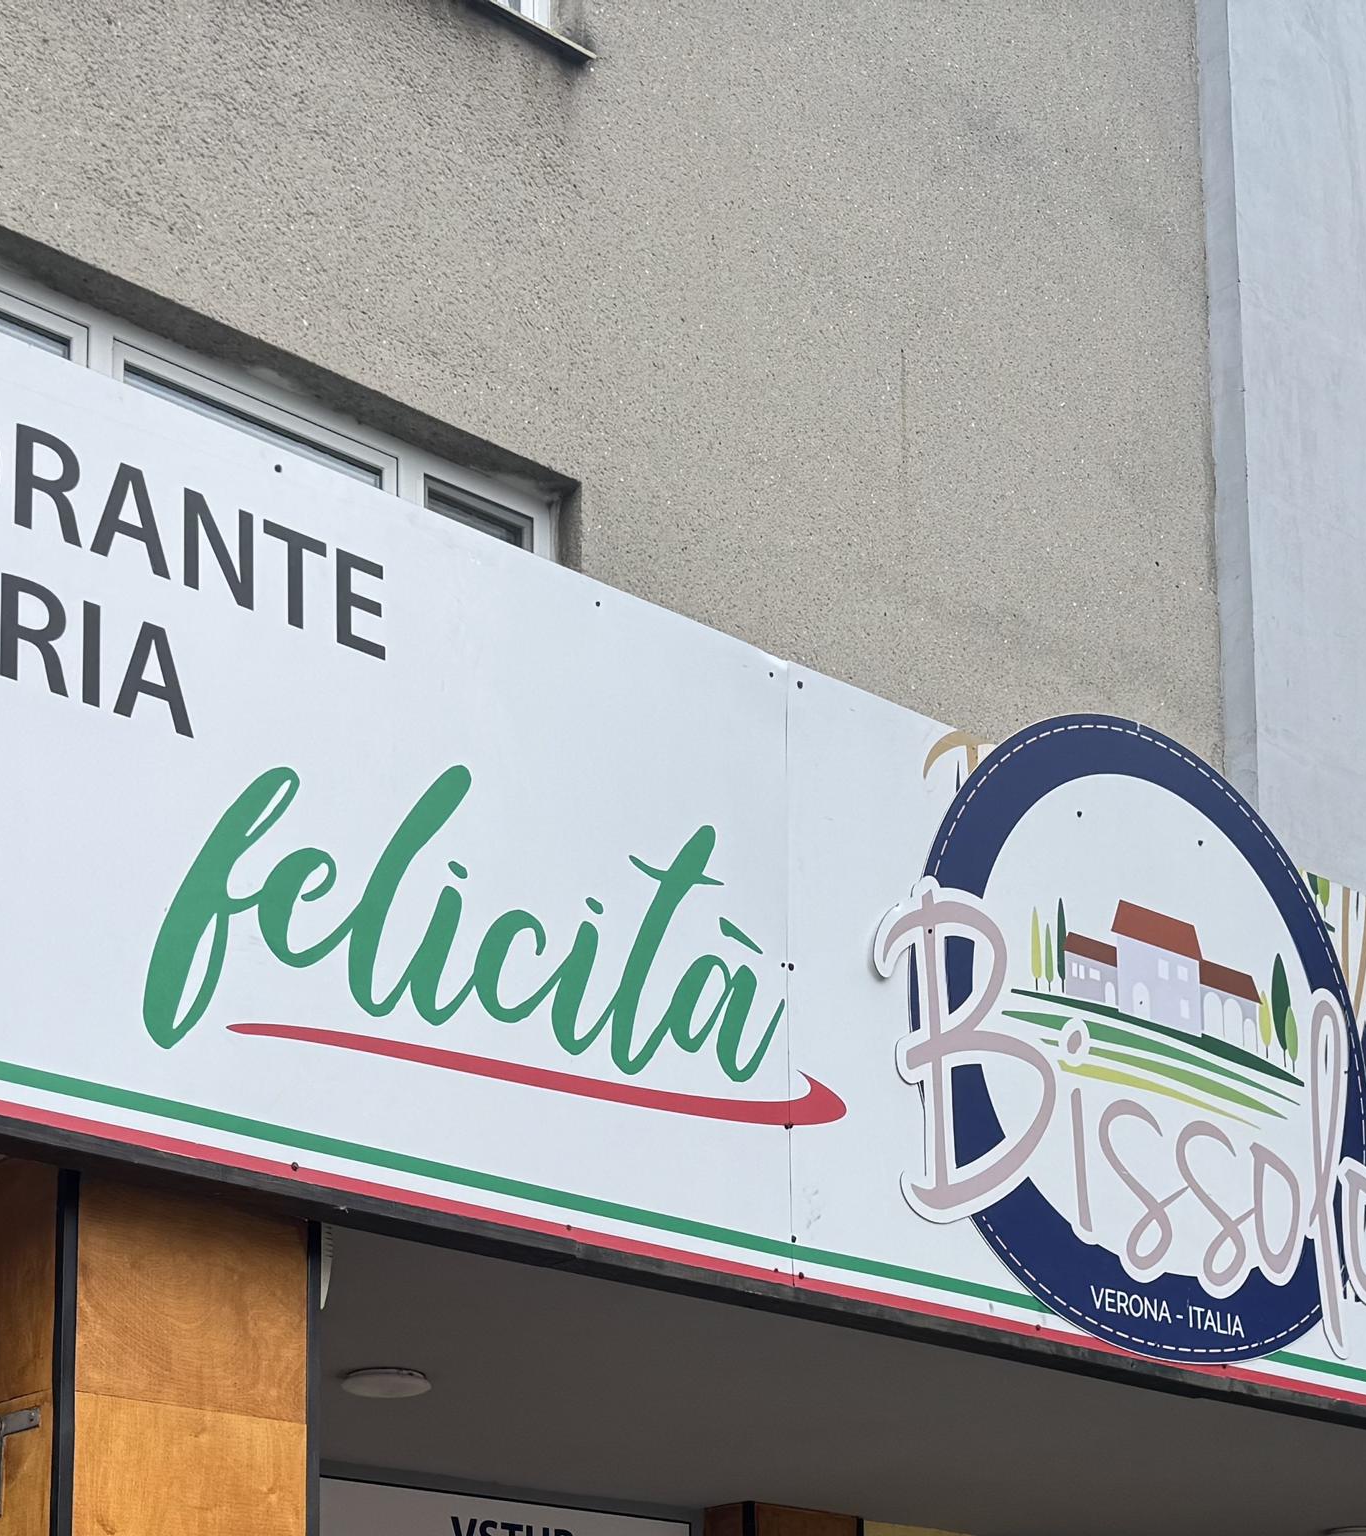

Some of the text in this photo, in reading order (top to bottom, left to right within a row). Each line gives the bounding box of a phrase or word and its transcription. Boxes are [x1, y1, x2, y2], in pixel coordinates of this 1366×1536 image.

[143, 764, 784, 1082] felicità
[1090, 1284, 1172, 1323] VERONA
[1188, 1305, 1245, 1338] ITALIA
